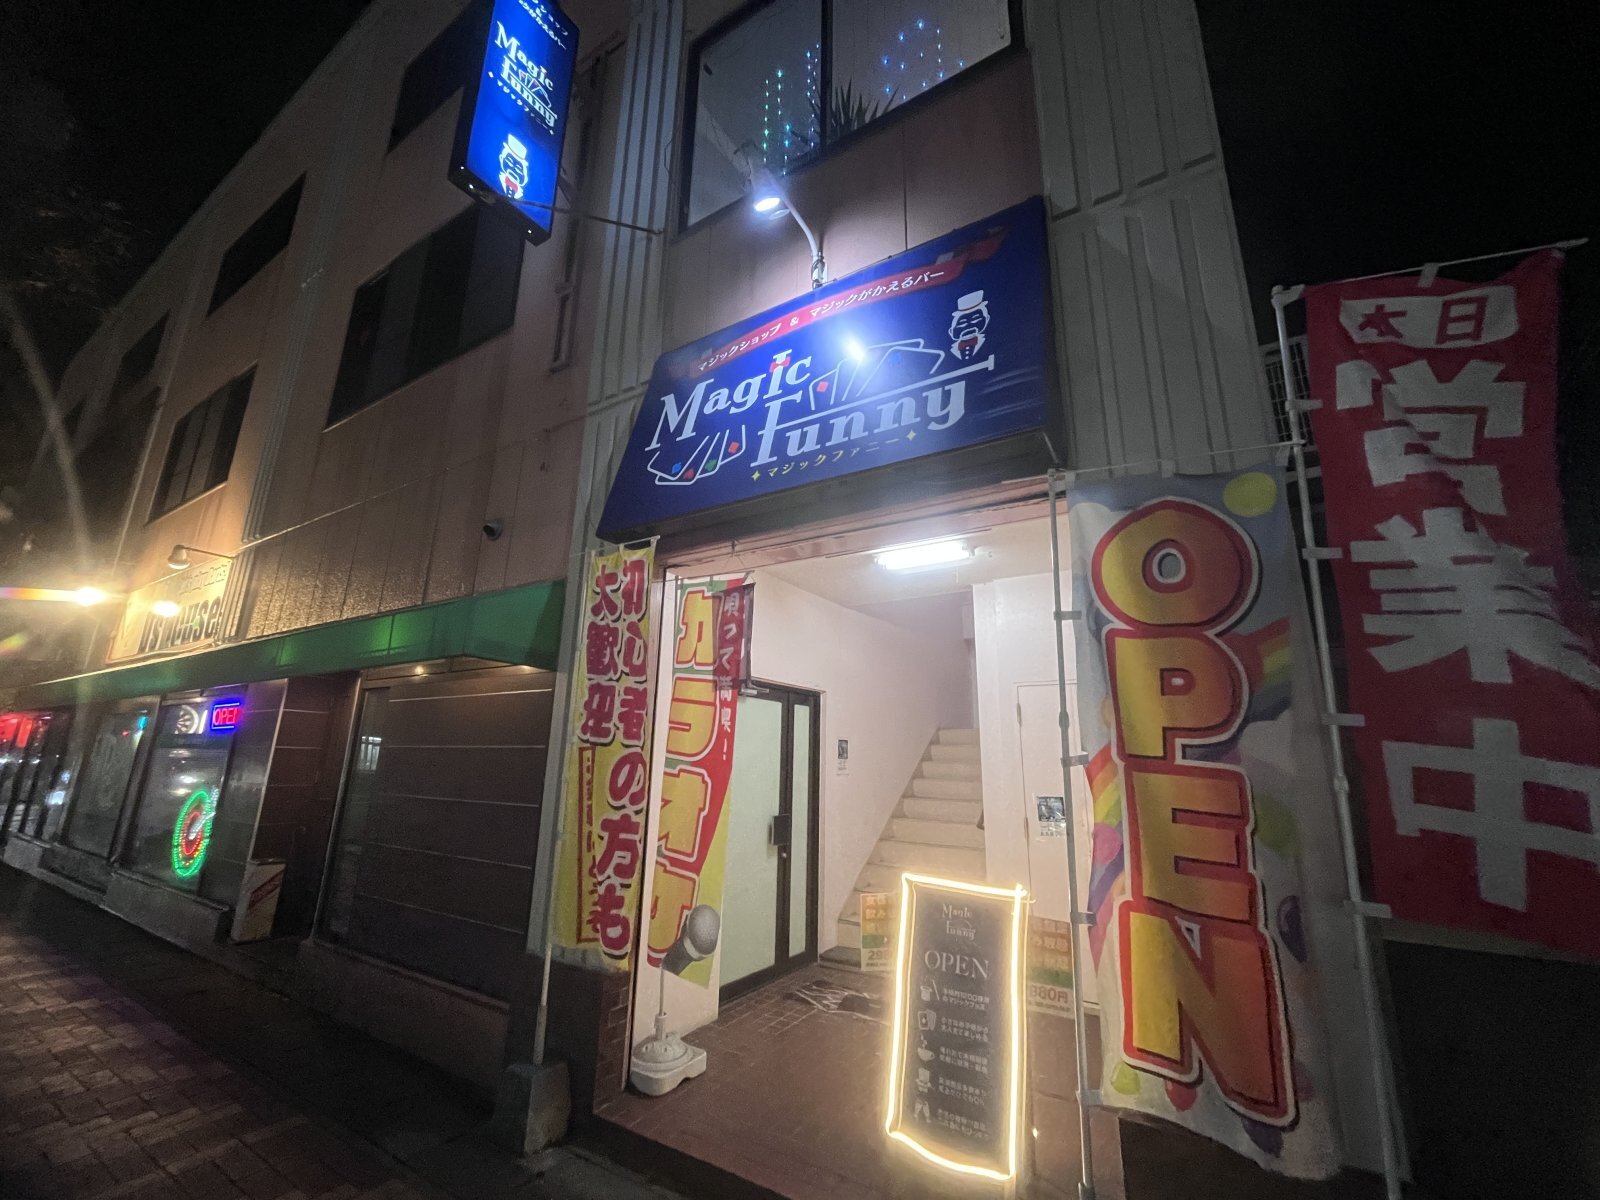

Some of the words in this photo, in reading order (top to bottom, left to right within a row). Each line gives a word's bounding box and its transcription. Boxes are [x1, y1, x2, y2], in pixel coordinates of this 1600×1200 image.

[495, 21, 554, 91] Magic
[501, 56, 557, 127] Funny
[697, 322, 782, 372] マジックショップ
[789, 316, 800, 327] &
[809, 271, 945, 317] マジックがかえるバー
[1357, 293, 1491, 345] 本日
[645, 349, 813, 452] Magic
[750, 354, 995, 468] Funny
[767, 438, 900, 478] マジックファニー
[581, 563, 621, 740] 大歓迎
[1336, 358, 1600, 913] 営業中
[599, 558, 650, 953] 初心者の方も
[648, 588, 720, 953] カラオケ
[1092, 497, 1297, 1127] OPEN
[924, 949, 989, 979] OPEN
